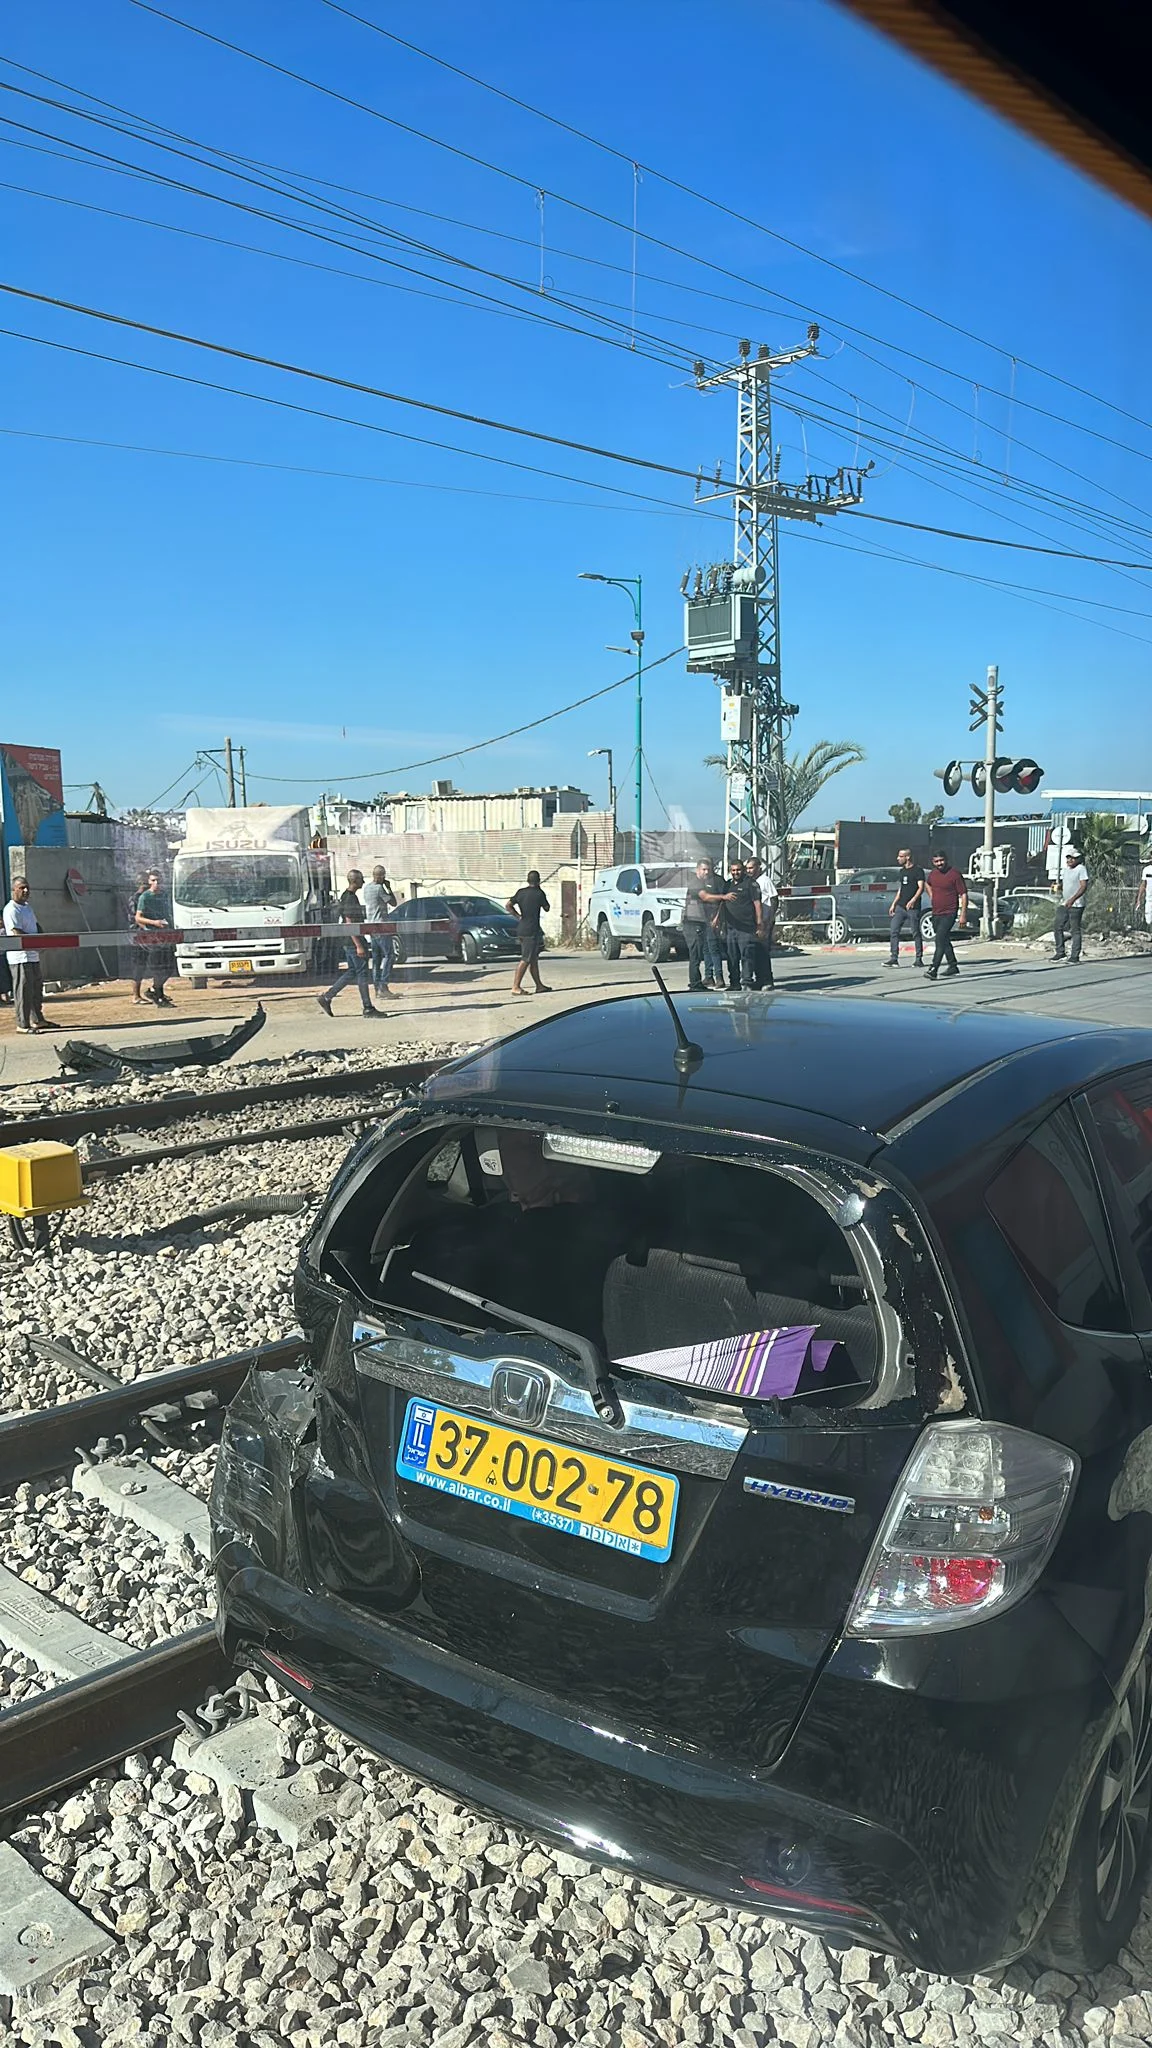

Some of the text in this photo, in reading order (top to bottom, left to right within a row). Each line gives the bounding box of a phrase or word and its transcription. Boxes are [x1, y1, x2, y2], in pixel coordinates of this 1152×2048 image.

[206, 840, 267, 850] ISUZU
[412, 1422, 426, 1449] IL
[416, 1471, 511, 1513] www.albar.co.il
[750, 1481, 848, 1508] HYBRID
